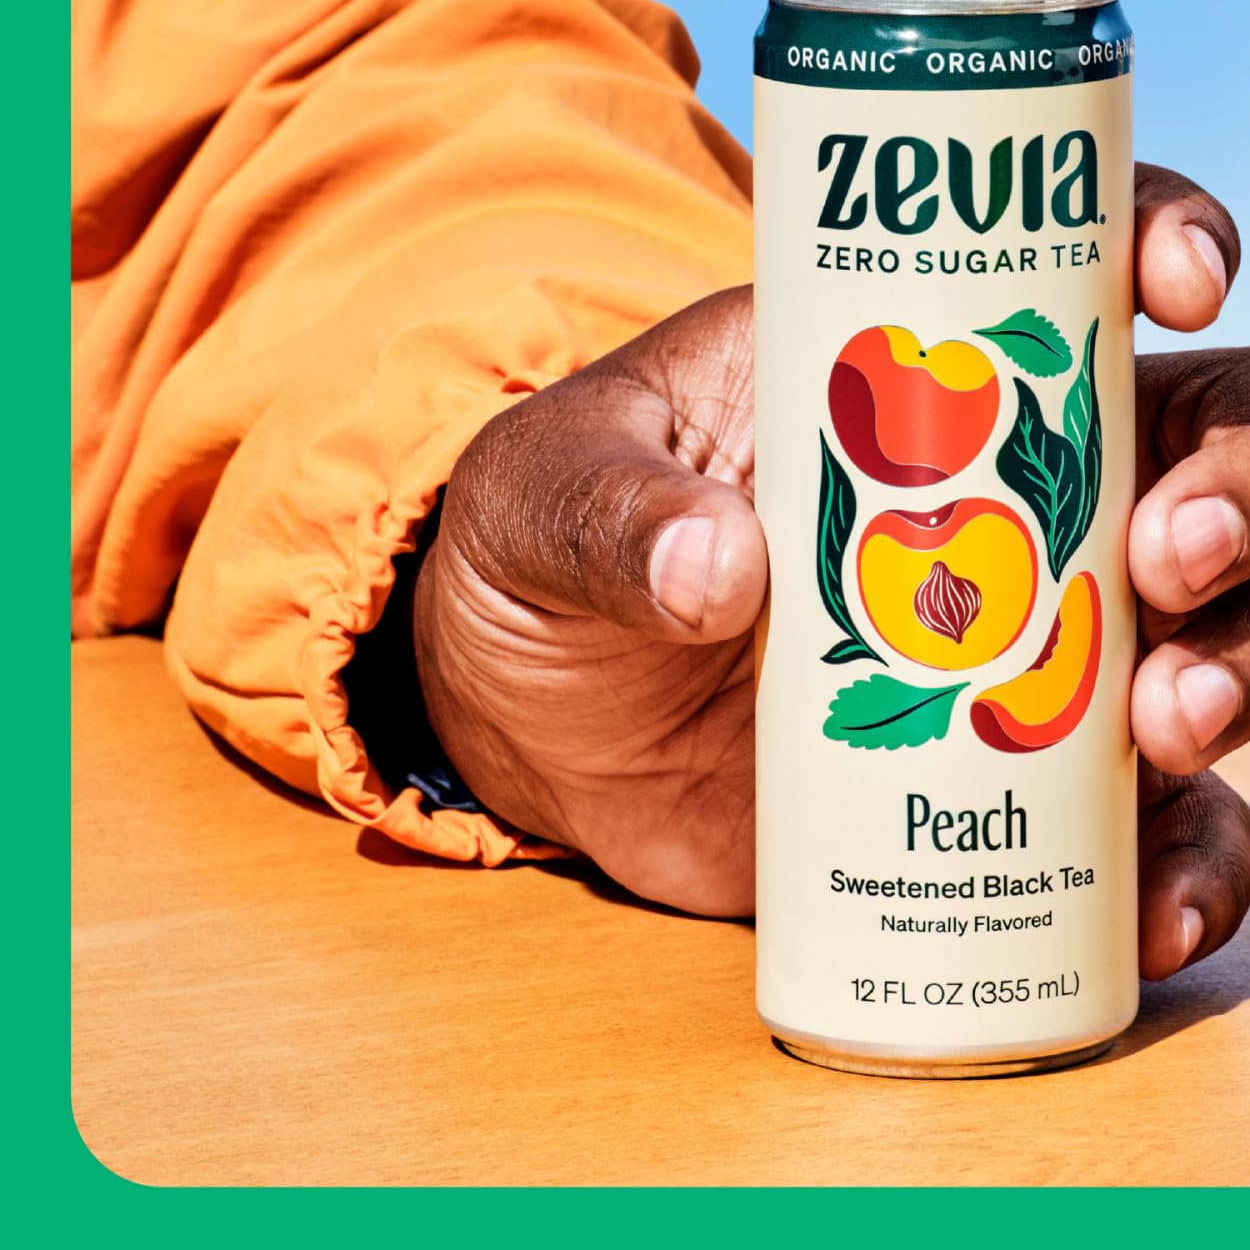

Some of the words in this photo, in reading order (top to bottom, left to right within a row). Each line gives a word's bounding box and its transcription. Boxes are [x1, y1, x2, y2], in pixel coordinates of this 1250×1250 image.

[787, 46, 895, 73] ORGANIC
[926, 49, 1053, 74] ORGANIC
[816, 244, 900, 272] ZERO
[915, 248, 1037, 275] SUGAR
[1050, 241, 1101, 269] TEA
[905, 789, 1028, 852] Peach
[830, 869, 975, 899] Sweetened
[983, 871, 1053, 898] Black
[1060, 867, 1095, 890] Tea
[881, 915, 969, 937] Naturally
[974, 911, 1053, 933] Flavored
[850, 979, 876, 1003] 12
[885, 981, 916, 1006] FL
[923, 982, 964, 1006] OZ
[972, 978, 1030, 1008] (355
[1038, 971, 1081, 1000] mL)
